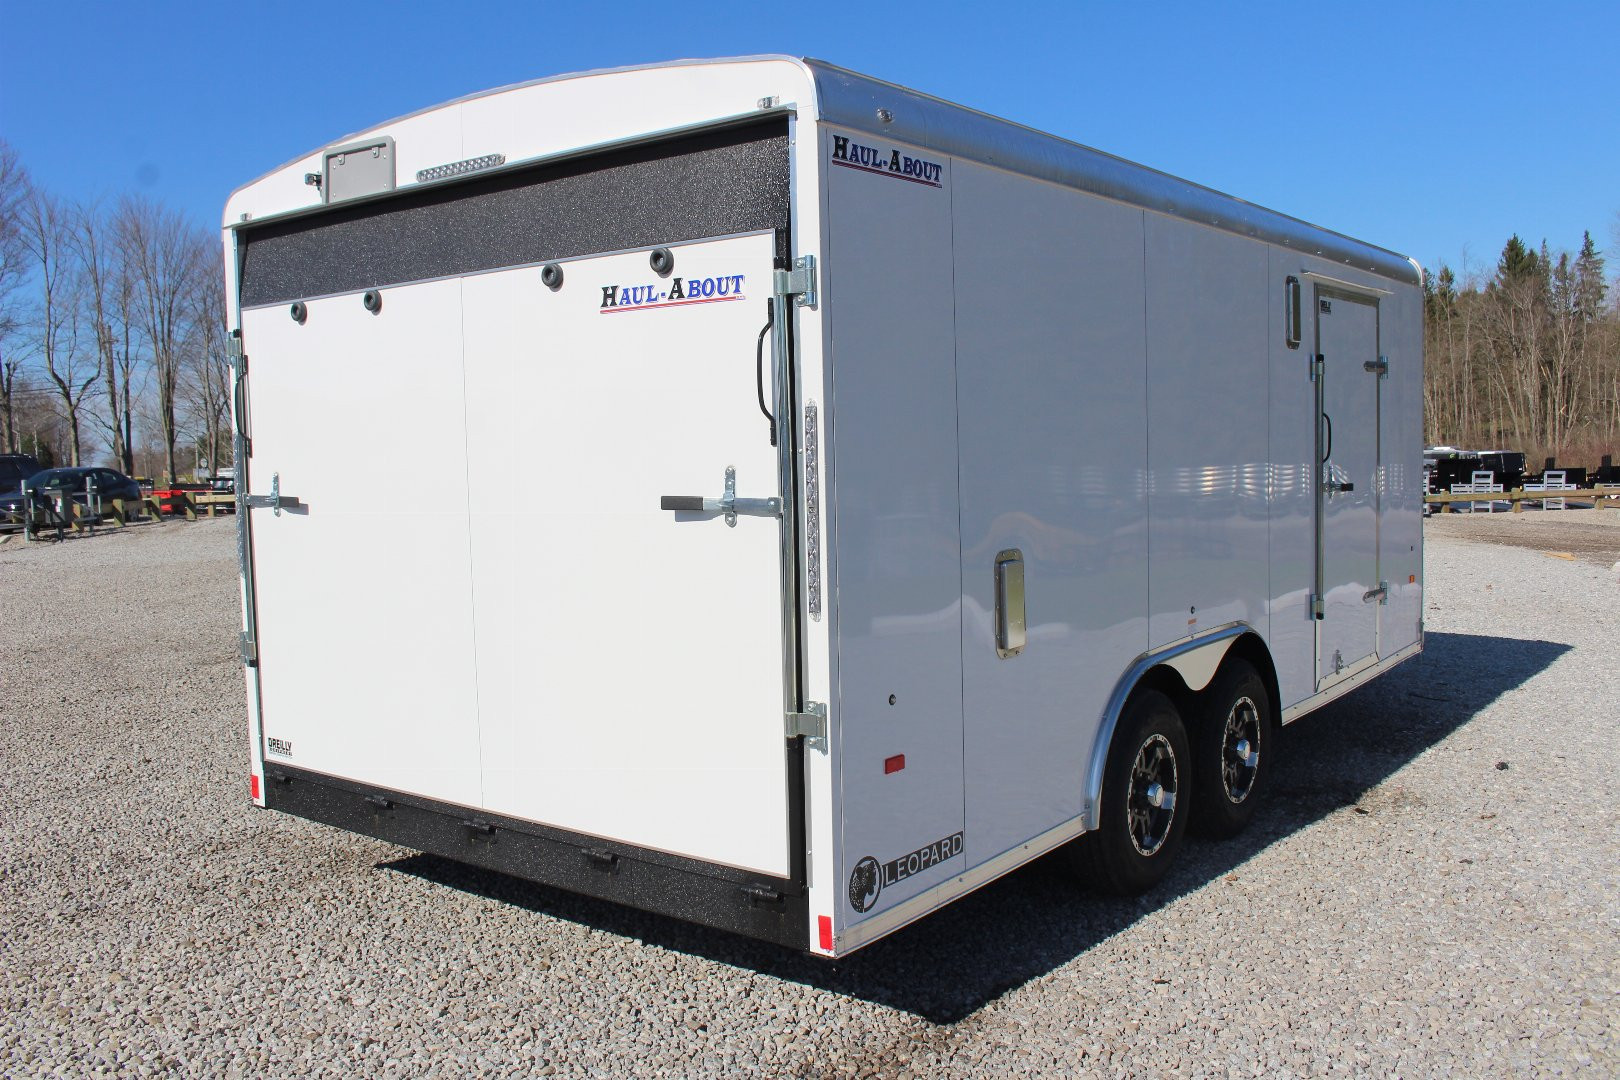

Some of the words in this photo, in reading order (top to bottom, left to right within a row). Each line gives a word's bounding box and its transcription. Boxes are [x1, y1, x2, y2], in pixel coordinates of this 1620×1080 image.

[832, 134, 942, 182] HAUL-ABOUT
[600, 274, 745, 308] HAUL-ABOUT
[884, 834, 963, 886] LEOPARD
